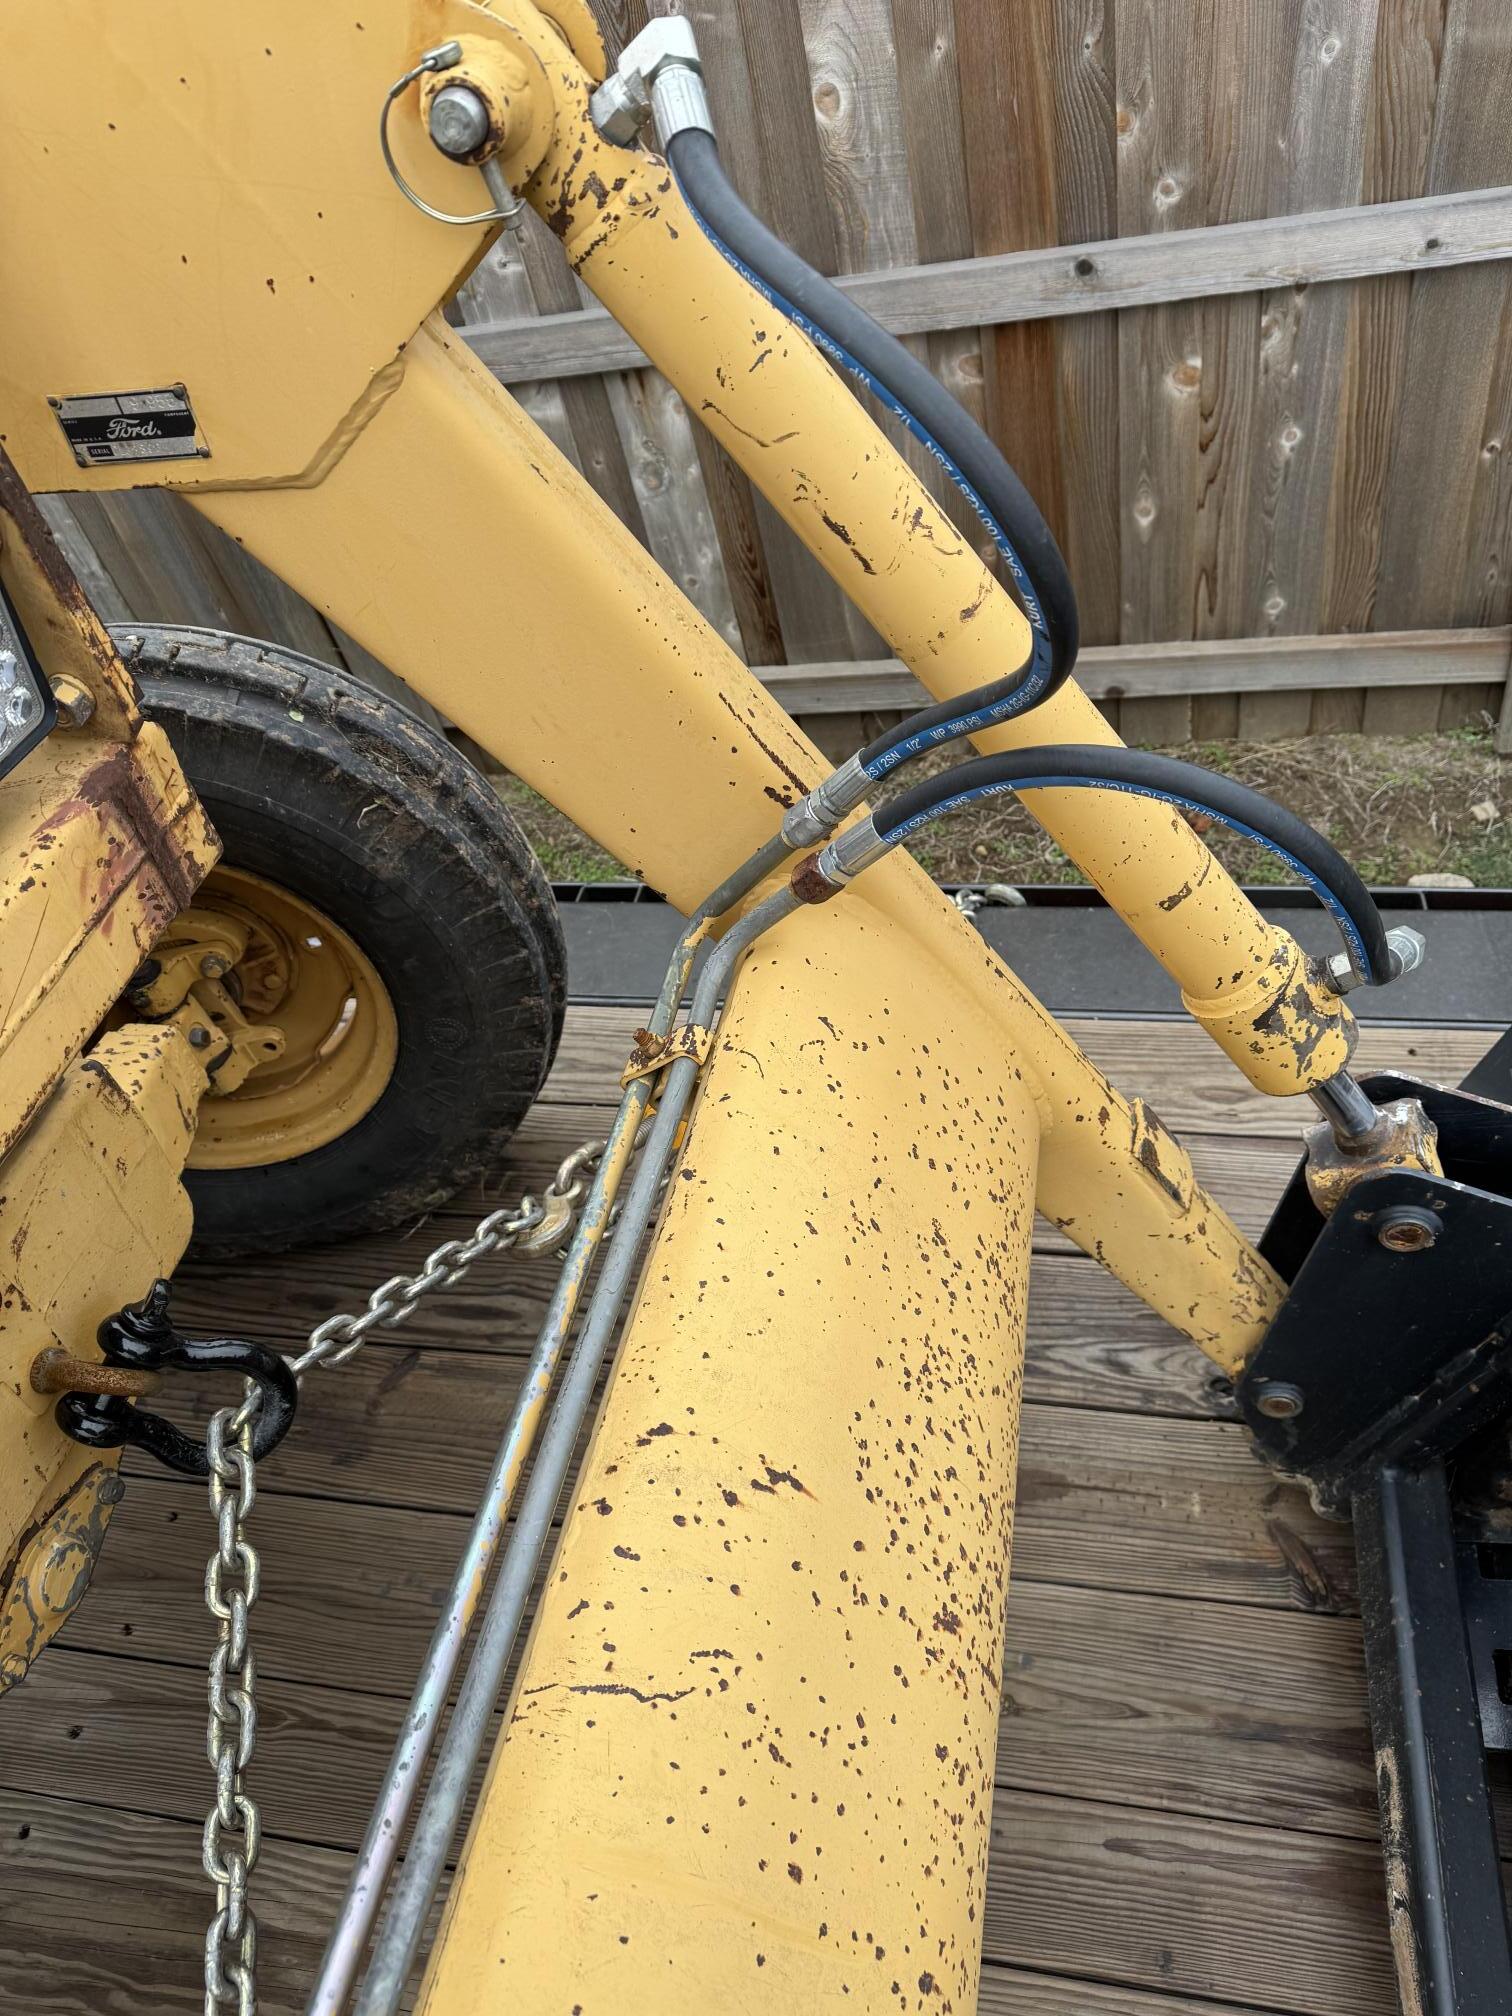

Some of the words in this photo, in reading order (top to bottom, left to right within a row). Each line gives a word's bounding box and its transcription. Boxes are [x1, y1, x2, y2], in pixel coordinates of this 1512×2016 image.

[106, 418, 157, 439] Ford
[925, 441, 954, 472] 2SN
[958, 483, 985, 514] R2S
[981, 516, 1002, 541] 100
[1000, 547, 1023, 578] SAE
[1022, 594, 1043, 630] KURT
[880, 750, 902, 768] 2SN
[929, 728, 946, 741] WP
[949, 720, 968, 735] 3990
[966, 716, 984, 729] PSI
[990, 703, 1011, 719] MSHA
[980, 784, 1015, 798] KURT
[929, 805, 947, 817] 100
[946, 796, 971, 809] SAE
[909, 815, 929, 829] R2S
[1185, 802, 1229, 826] MSHA
[884, 828, 904, 844] 2SN
[1248, 834, 1272, 851] PSI
[1298, 871, 1318, 886] WP
